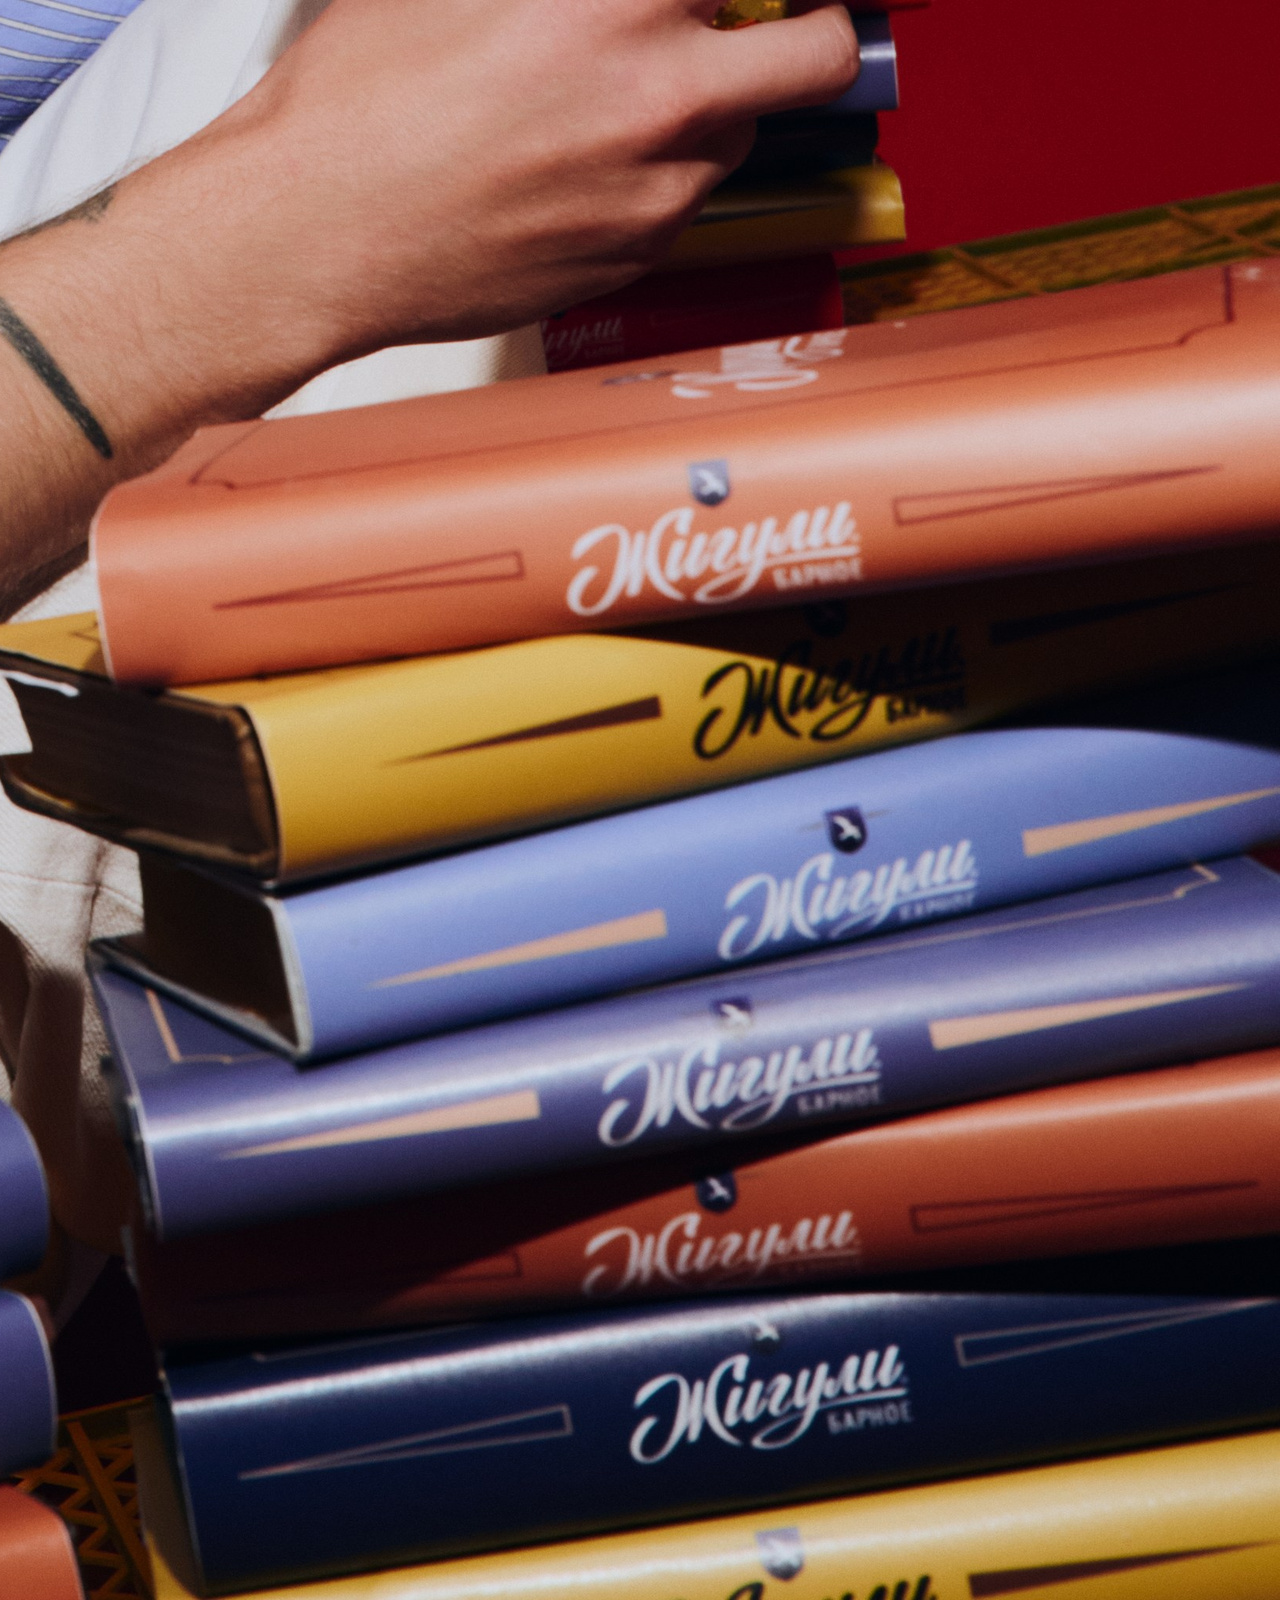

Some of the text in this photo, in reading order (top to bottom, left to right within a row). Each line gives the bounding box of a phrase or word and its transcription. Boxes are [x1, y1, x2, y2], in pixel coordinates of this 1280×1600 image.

[566, 500, 860, 616] Жигули
[693, 625, 967, 760] Жигули
[718, 839, 978, 962] Жигули
[597, 1028, 882, 1147] Жигули
[582, 1210, 862, 1296] Жигули
[629, 1344, 910, 1465] Жигули
[826, 1400, 914, 1435] БАРНОЕ
